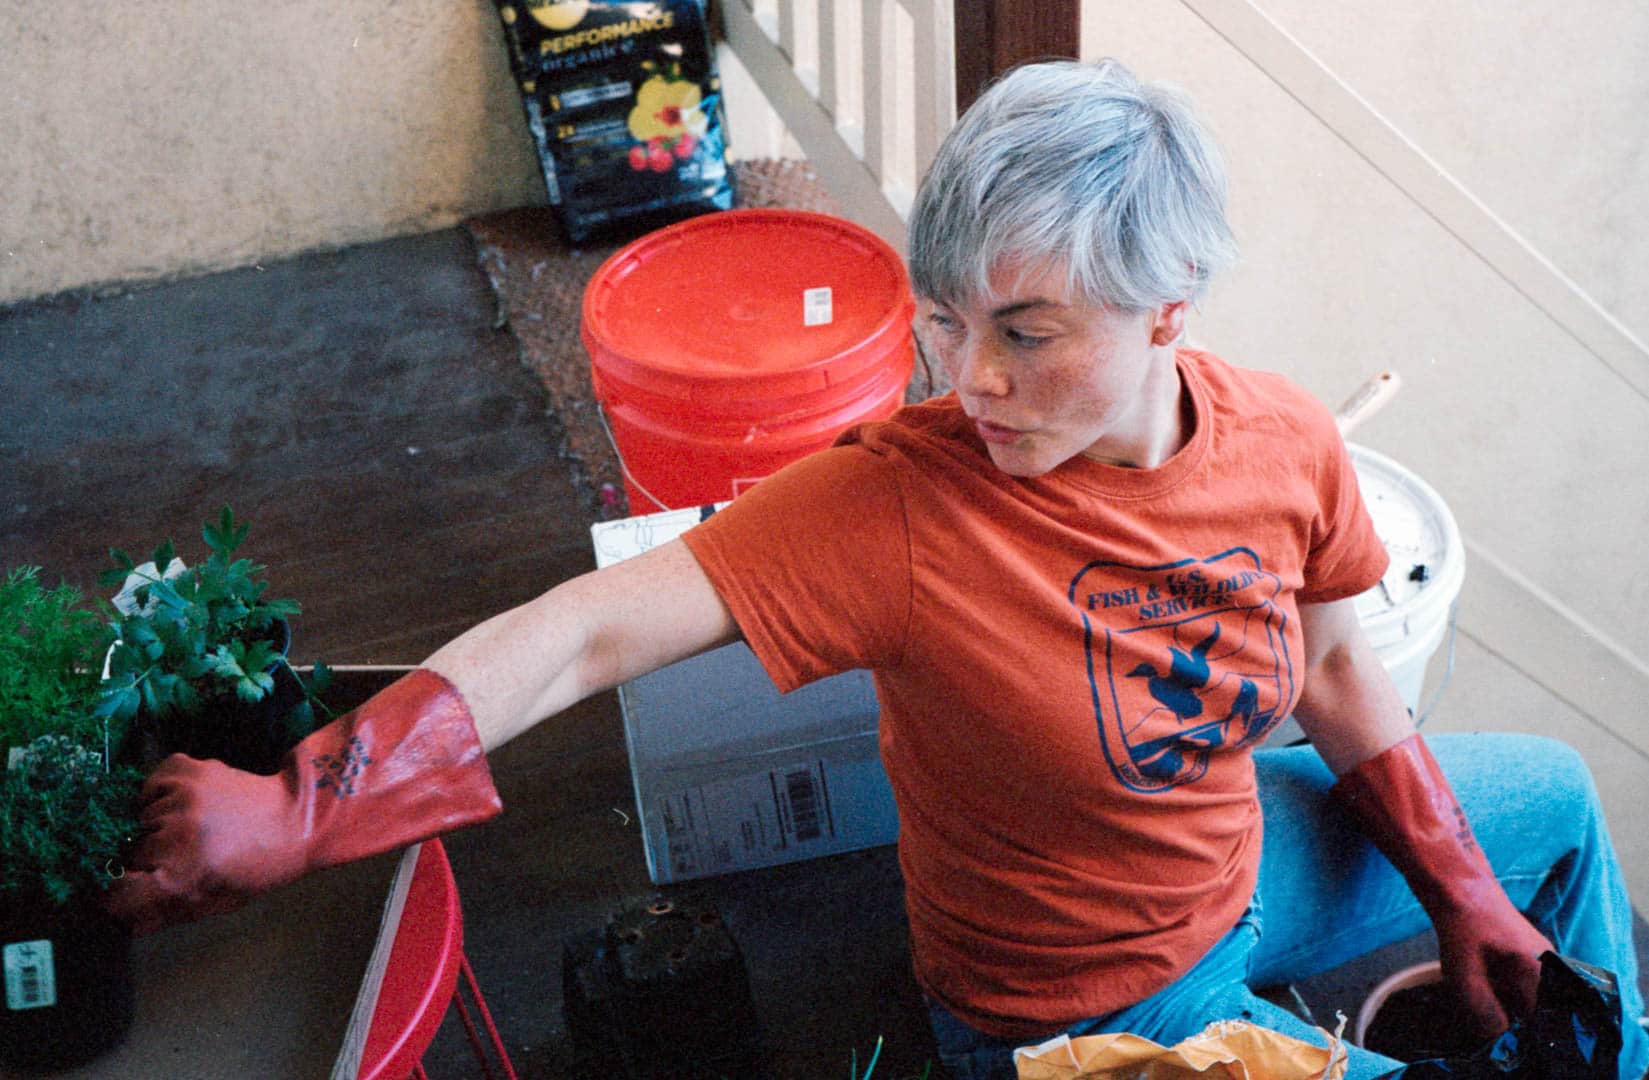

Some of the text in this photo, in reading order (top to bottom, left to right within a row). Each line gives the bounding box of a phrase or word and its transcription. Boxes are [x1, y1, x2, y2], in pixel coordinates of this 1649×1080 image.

[541, 11, 674, 56] PERFORMANCE
[1087, 587, 1140, 611] FISH
[1146, 583, 1161, 601] &
[1138, 592, 1233, 621] SERVICE
